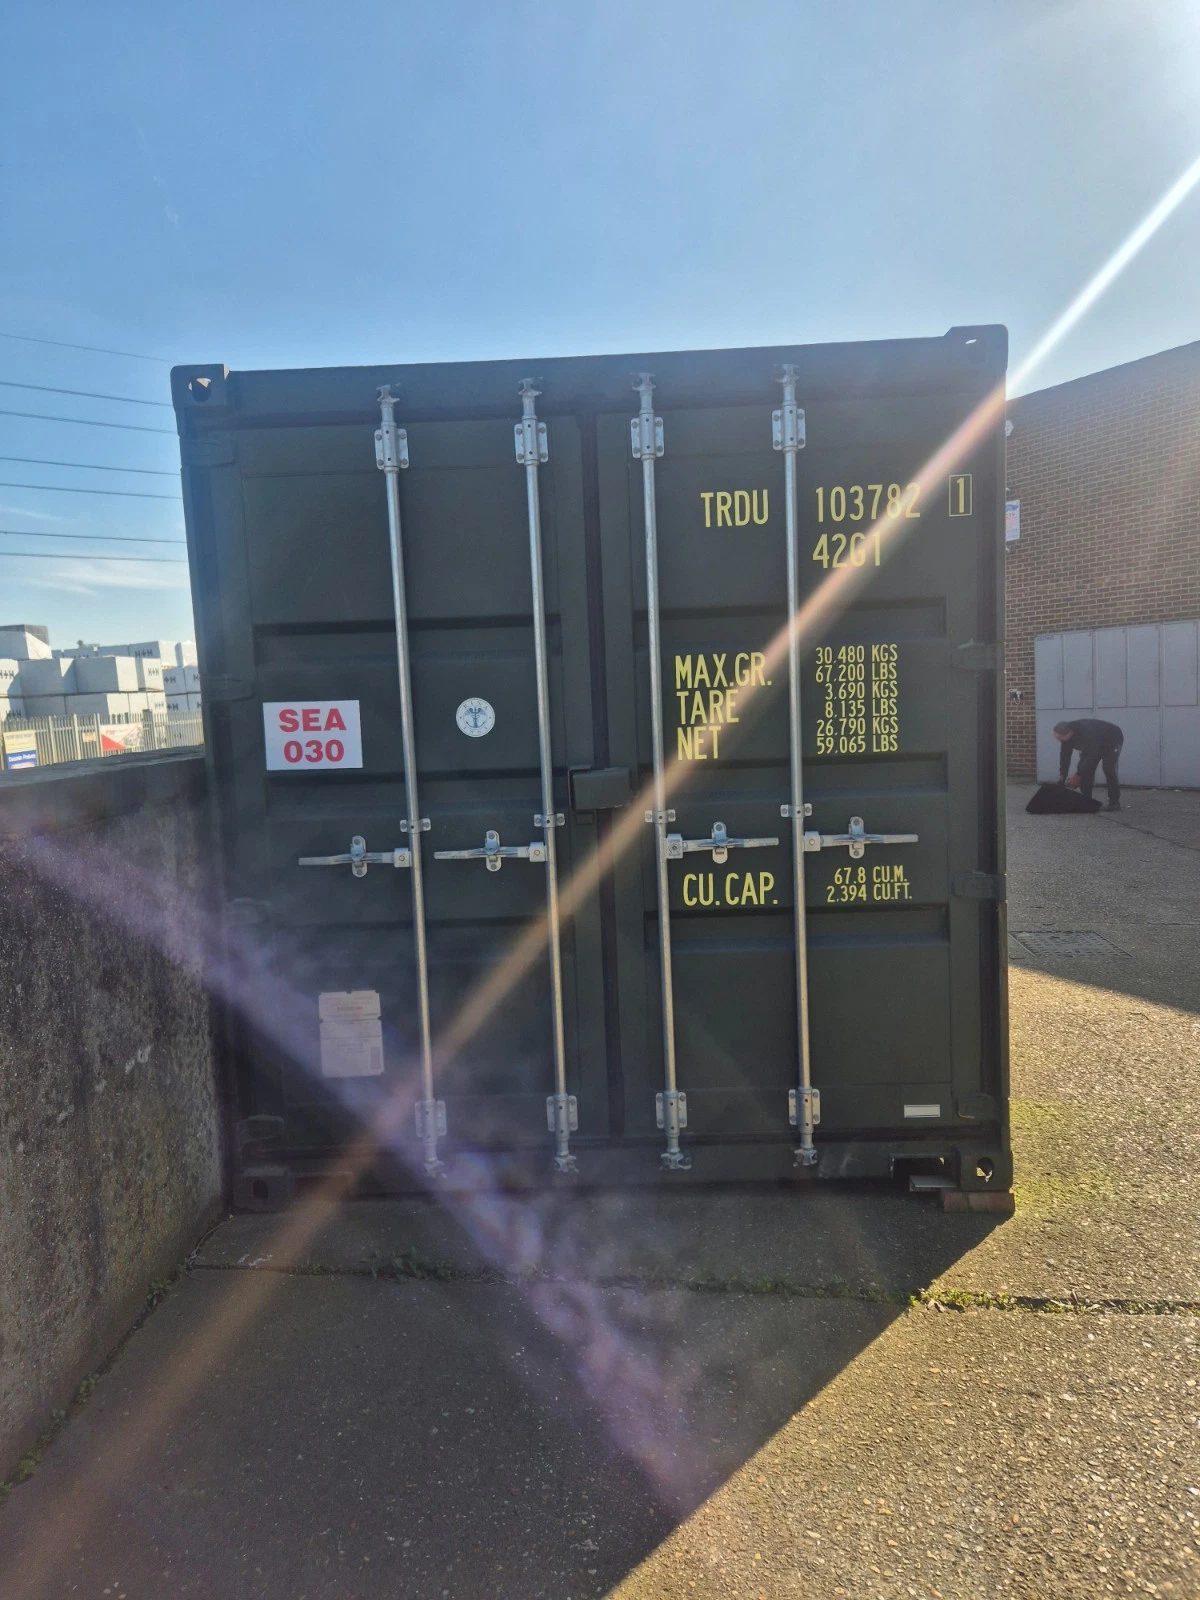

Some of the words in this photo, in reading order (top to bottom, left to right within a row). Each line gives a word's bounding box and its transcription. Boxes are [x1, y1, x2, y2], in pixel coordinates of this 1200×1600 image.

[700, 489, 769, 528] TRDU
[815, 482, 921, 523] 103782
[812, 532, 881, 569] 42G1
[815, 646, 865, 664] 30.480
[871, 643, 898, 662] KGS
[675, 652, 772, 689] MAX.GR.
[815, 663, 865, 683] 67.200
[871, 662, 898, 681] LBS
[825, 682, 865, 700] 3.690
[872, 680, 898, 699] KGS
[676, 689, 739, 725] TARE
[825, 700, 865, 718] 8.135
[872, 698, 898, 717] LBS
[279, 708, 347, 732] SEA
[816, 718, 866, 737] 26.790
[872, 716, 899, 735] KGS
[284, 739, 345, 763] 030
[677, 725, 721, 761] NET
[816, 736, 866, 755] 59.065
[872, 734, 898, 753] LBS
[834, 867, 866, 885] 67.8
[873, 865, 908, 883] CU.M.
[827, 884, 867, 903] 2.394
[873, 882, 913, 900] CU.FT.
